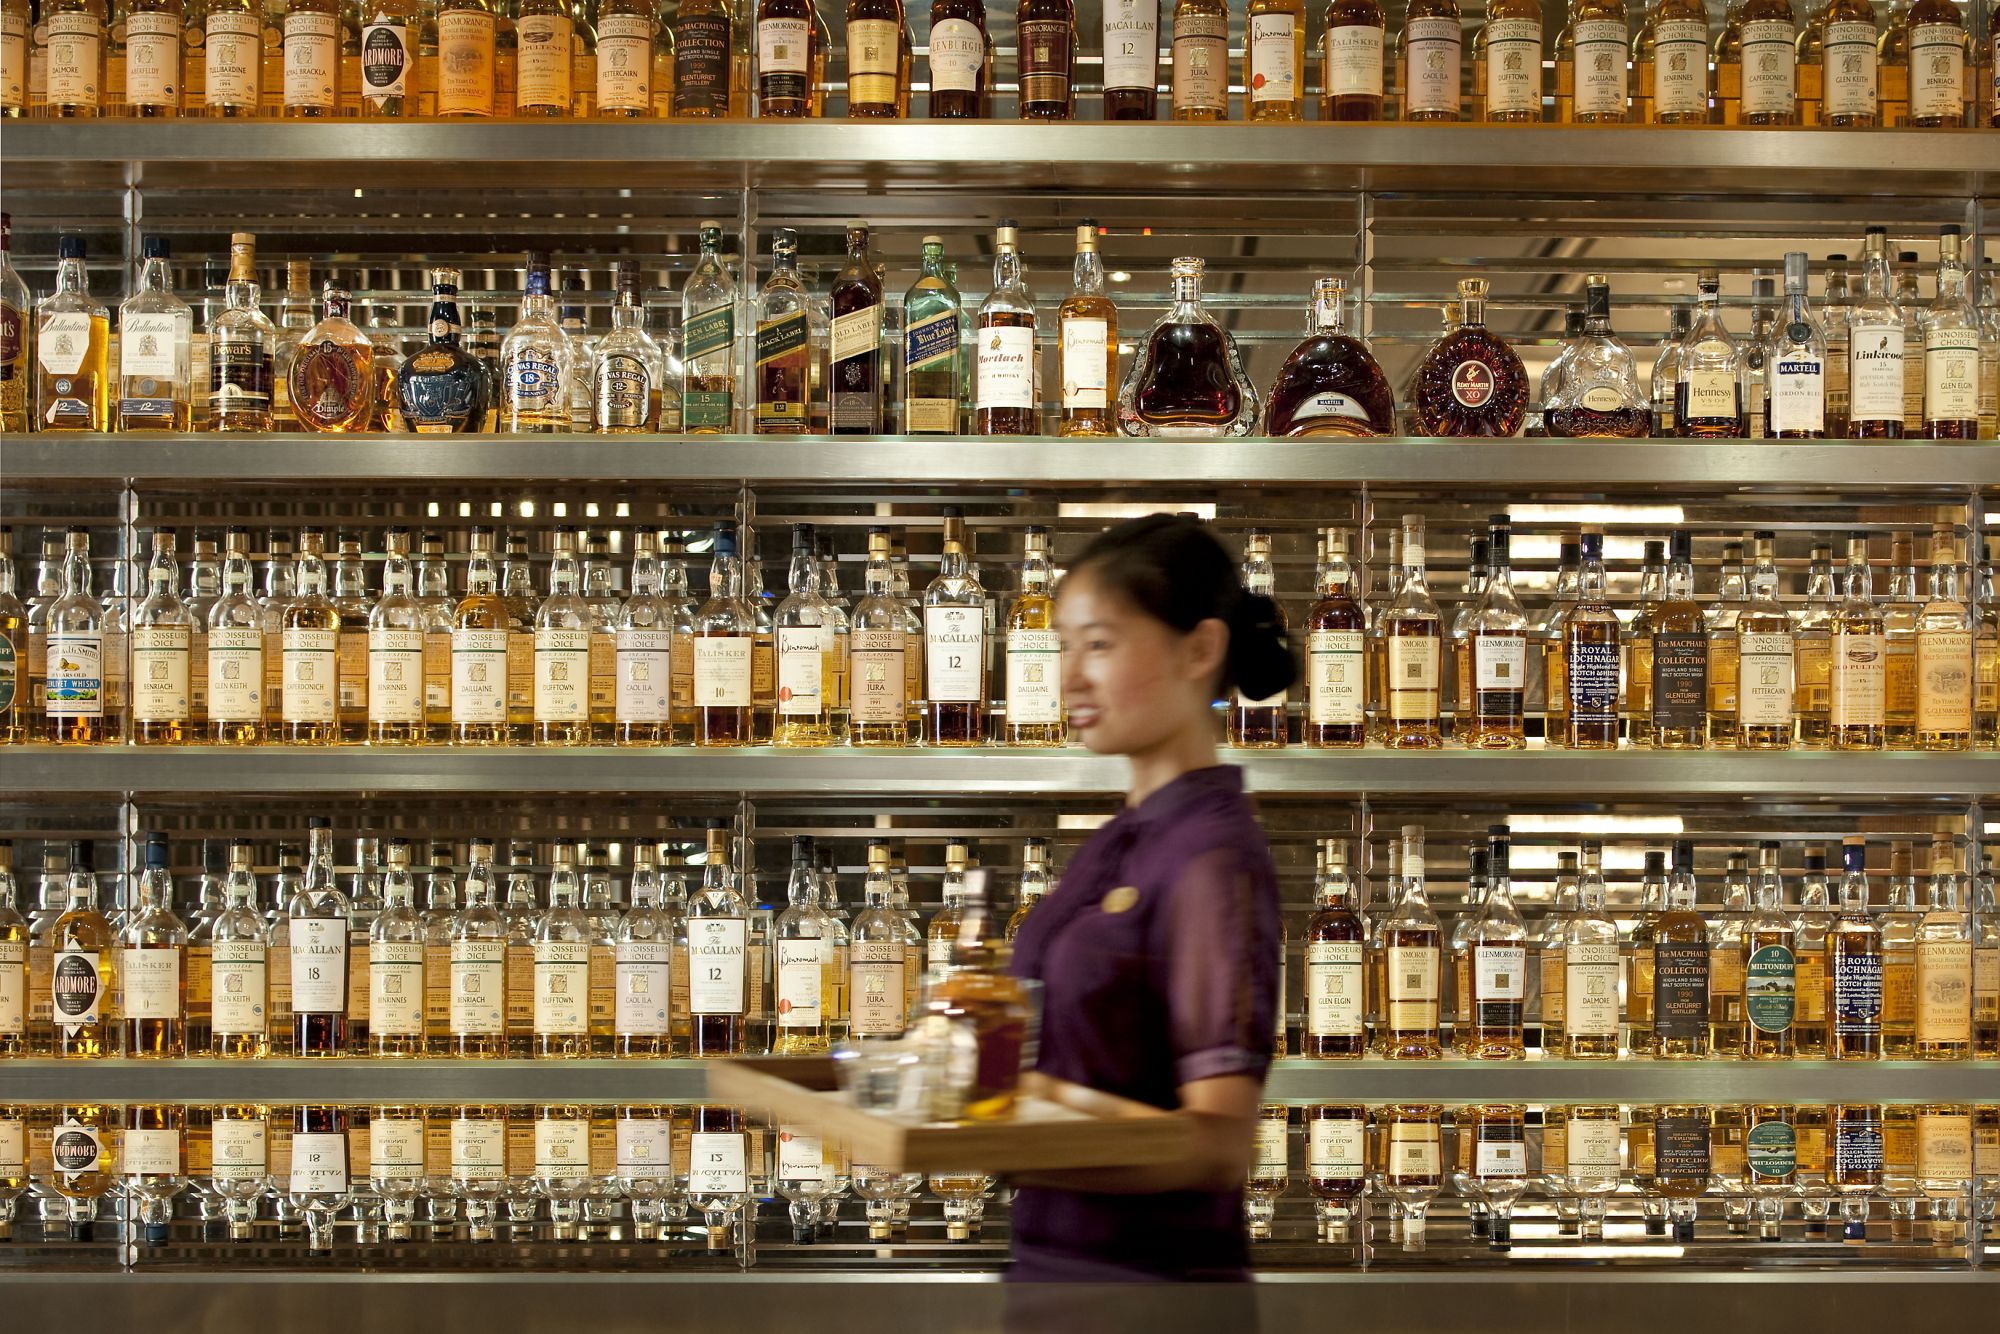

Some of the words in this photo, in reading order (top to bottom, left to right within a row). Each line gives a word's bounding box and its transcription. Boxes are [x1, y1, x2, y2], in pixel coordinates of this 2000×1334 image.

[52, 24, 81, 32] CHOICE
[131, 24, 160, 32] CHOICE
[604, 27, 634, 35] CHOICE
[683, 22, 725, 31] MACPHAIL'S
[1105, 22, 1154, 32] MACALLAN
[1184, 27, 1215, 35] CHOICE
[1254, 22, 1293, 47] Benromach
[1836, 33, 1866, 41] CHOICE
[677, 39, 725, 49] COLLECTION
[1331, 38, 1379, 47] TALISKER
[1122, 42, 1134, 54] 12
[364, 48, 403, 66] ARDMORE
[52, 66, 79, 74] DALMORE
[300, 68, 326, 76] BRACKLA
[603, 70, 638, 78] FETTERCAIRN
[1190, 69, 1208, 77] JURA
[1498, 73, 1529, 81] DUFFTOWN
[705, 319, 729, 332] LABEL
[781, 328, 804, 340] LABEL
[917, 333, 936, 346] Blue
[936, 325, 956, 339] Label
[1940, 339, 1971, 347] CHOICE
[214, 343, 252, 355] Dewar's
[226, 355, 235, 363] 12
[533, 361, 557, 375] REGAL
[1780, 364, 1818, 373] MARTELL
[525, 373, 535, 383] 18
[622, 371, 646, 384] REGAL
[1957, 382, 1972, 390] ELGIN
[1466, 391, 1480, 399] XO
[1693, 387, 1731, 399] Hennessy
[701, 394, 710, 402] 15
[1588, 395, 1618, 404] Hennessy
[140, 400, 155, 412] 12
[316, 403, 345, 413] Dimple
[929, 634, 980, 644] MACALLAN
[1018, 641, 1049, 649] CHOICE
[1755, 644, 1785, 652] CHOICE
[697, 649, 746, 657] TALISKER
[1581, 646, 1612, 654] ROYAL
[948, 656, 961, 668] 12
[1658, 656, 1706, 665] COLLECTION
[144, 683, 173, 691] BENRIACH
[715, 687, 725, 698] 10
[292, 945, 342, 954] MACALLAN
[691, 946, 743, 955] MACALLAN
[1771, 950, 1779, 958] 10
[1581, 953, 1612, 961] CHOICE
[1847, 957, 1878, 965] ROYAL
[1659, 967, 1708, 975] COLLECTION
[1751, 963, 1794, 971] MILTONDUFF
[308, 967, 320, 980] 18
[708, 967, 722, 980] 12
[56, 976, 95, 994] ARDMORE
[233, 995, 251, 1003] KEITH
